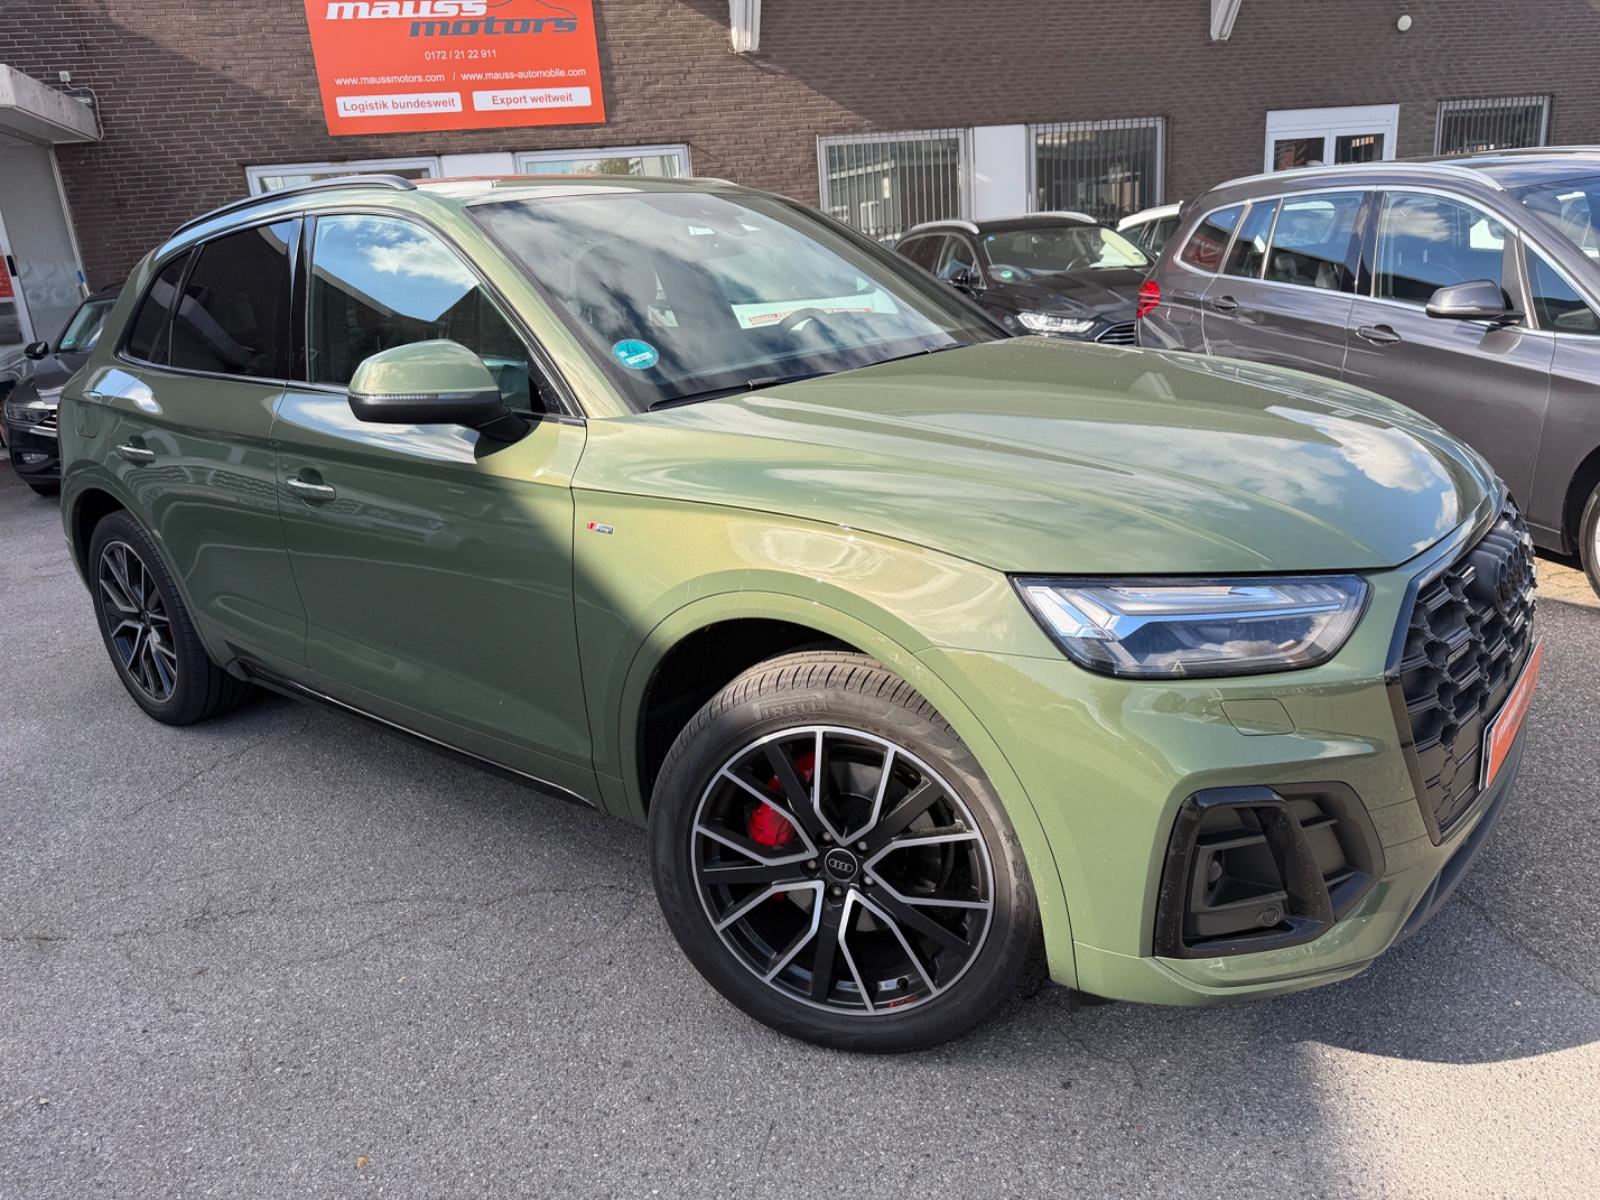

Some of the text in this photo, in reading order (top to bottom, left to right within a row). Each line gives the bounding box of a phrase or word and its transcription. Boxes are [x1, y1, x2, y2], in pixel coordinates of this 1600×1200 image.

[326, 0, 487, 19] mauss
[409, 16, 577, 37] motors
[424, 50, 448, 60] 0172
[454, 50, 465, 60] 21
[467, 49, 480, 59] 22
[481, 48, 497, 58] 911
[335, 73, 445, 86] www.maussmotors.com
[460, 67, 587, 81] www.mauss-automobile.com
[343, 97, 456, 113] Logistik bundesweit
[492, 92, 573, 106] Export weltweit
